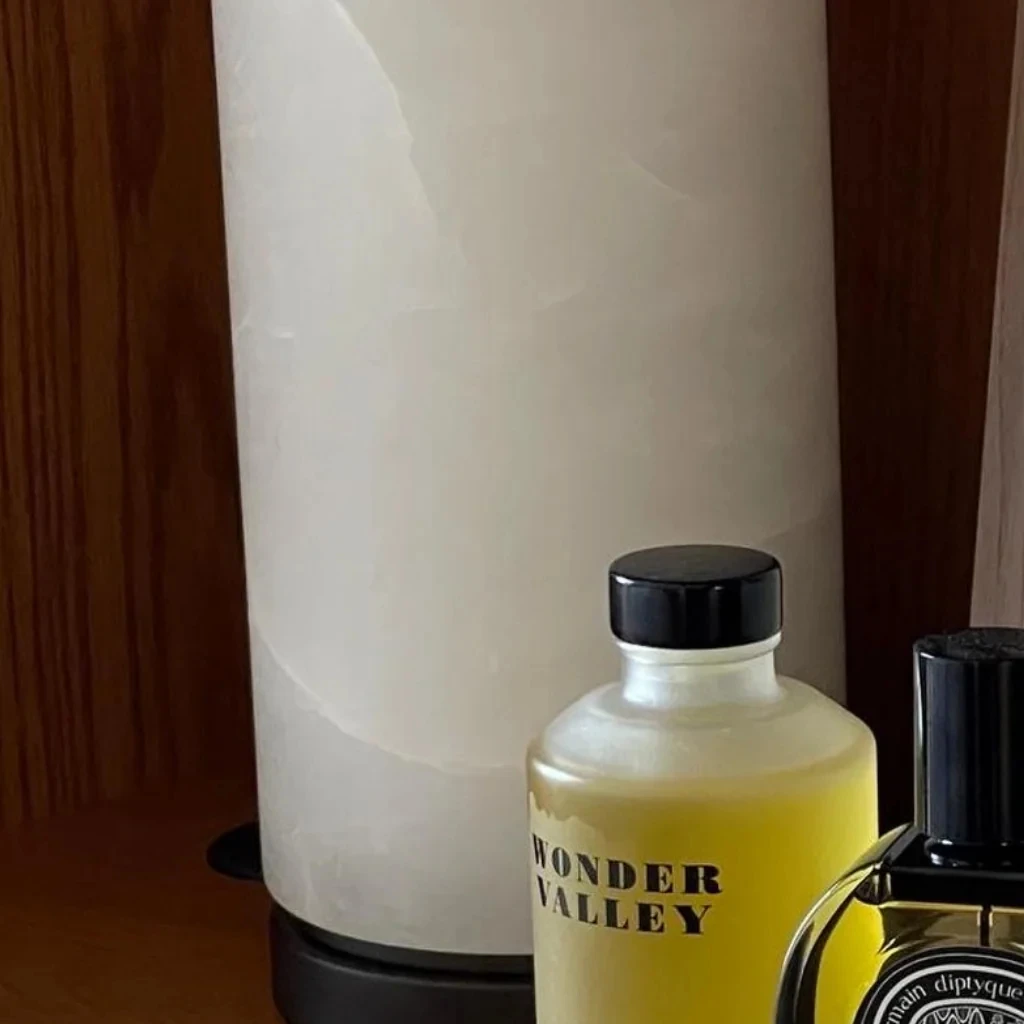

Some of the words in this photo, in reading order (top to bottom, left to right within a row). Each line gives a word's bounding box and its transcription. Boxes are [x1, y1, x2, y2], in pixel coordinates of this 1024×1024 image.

[532, 832, 723, 895] WONDER
[536, 874, 713, 935] VALLEY
[934, 974, 1024, 1000] diptyque
